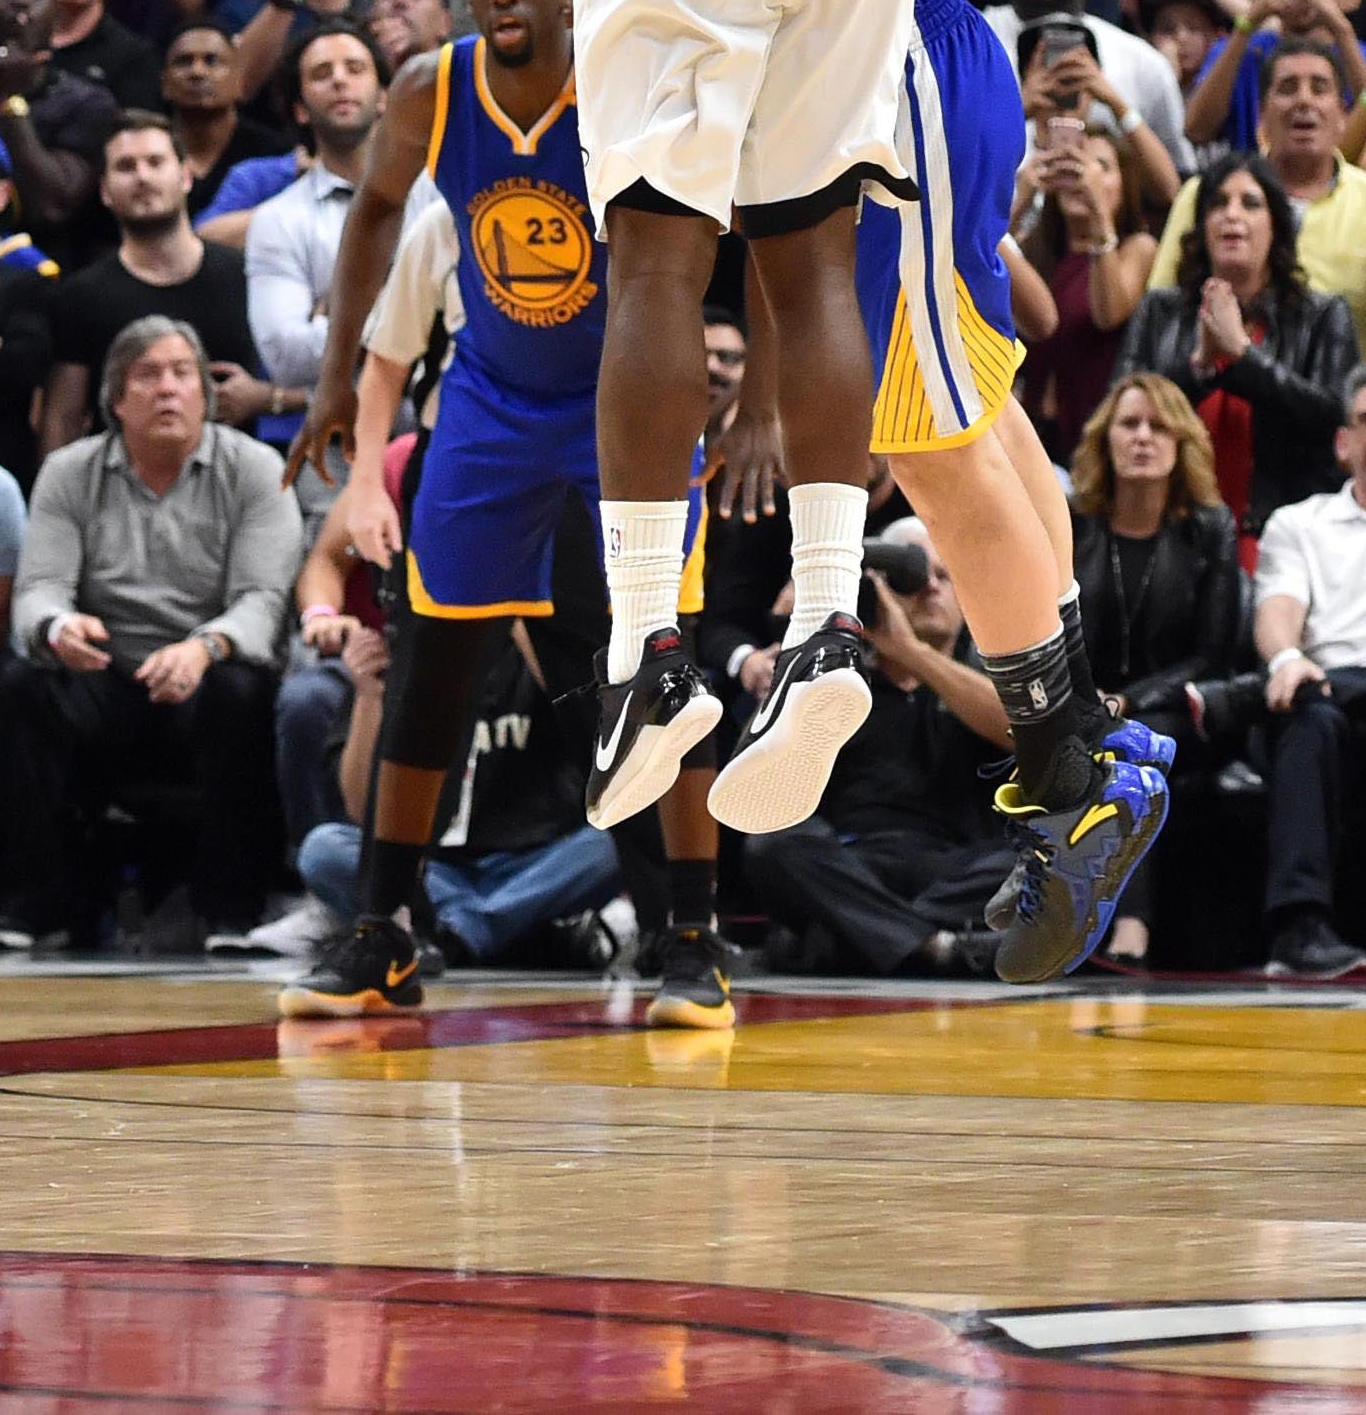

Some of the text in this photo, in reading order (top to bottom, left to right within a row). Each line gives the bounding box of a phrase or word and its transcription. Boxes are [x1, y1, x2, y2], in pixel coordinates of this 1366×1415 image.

[466, 176, 588, 218] GOLDEN STATE
[526, 217, 568, 246] 23
[484, 280, 599, 328] WARRIORS
